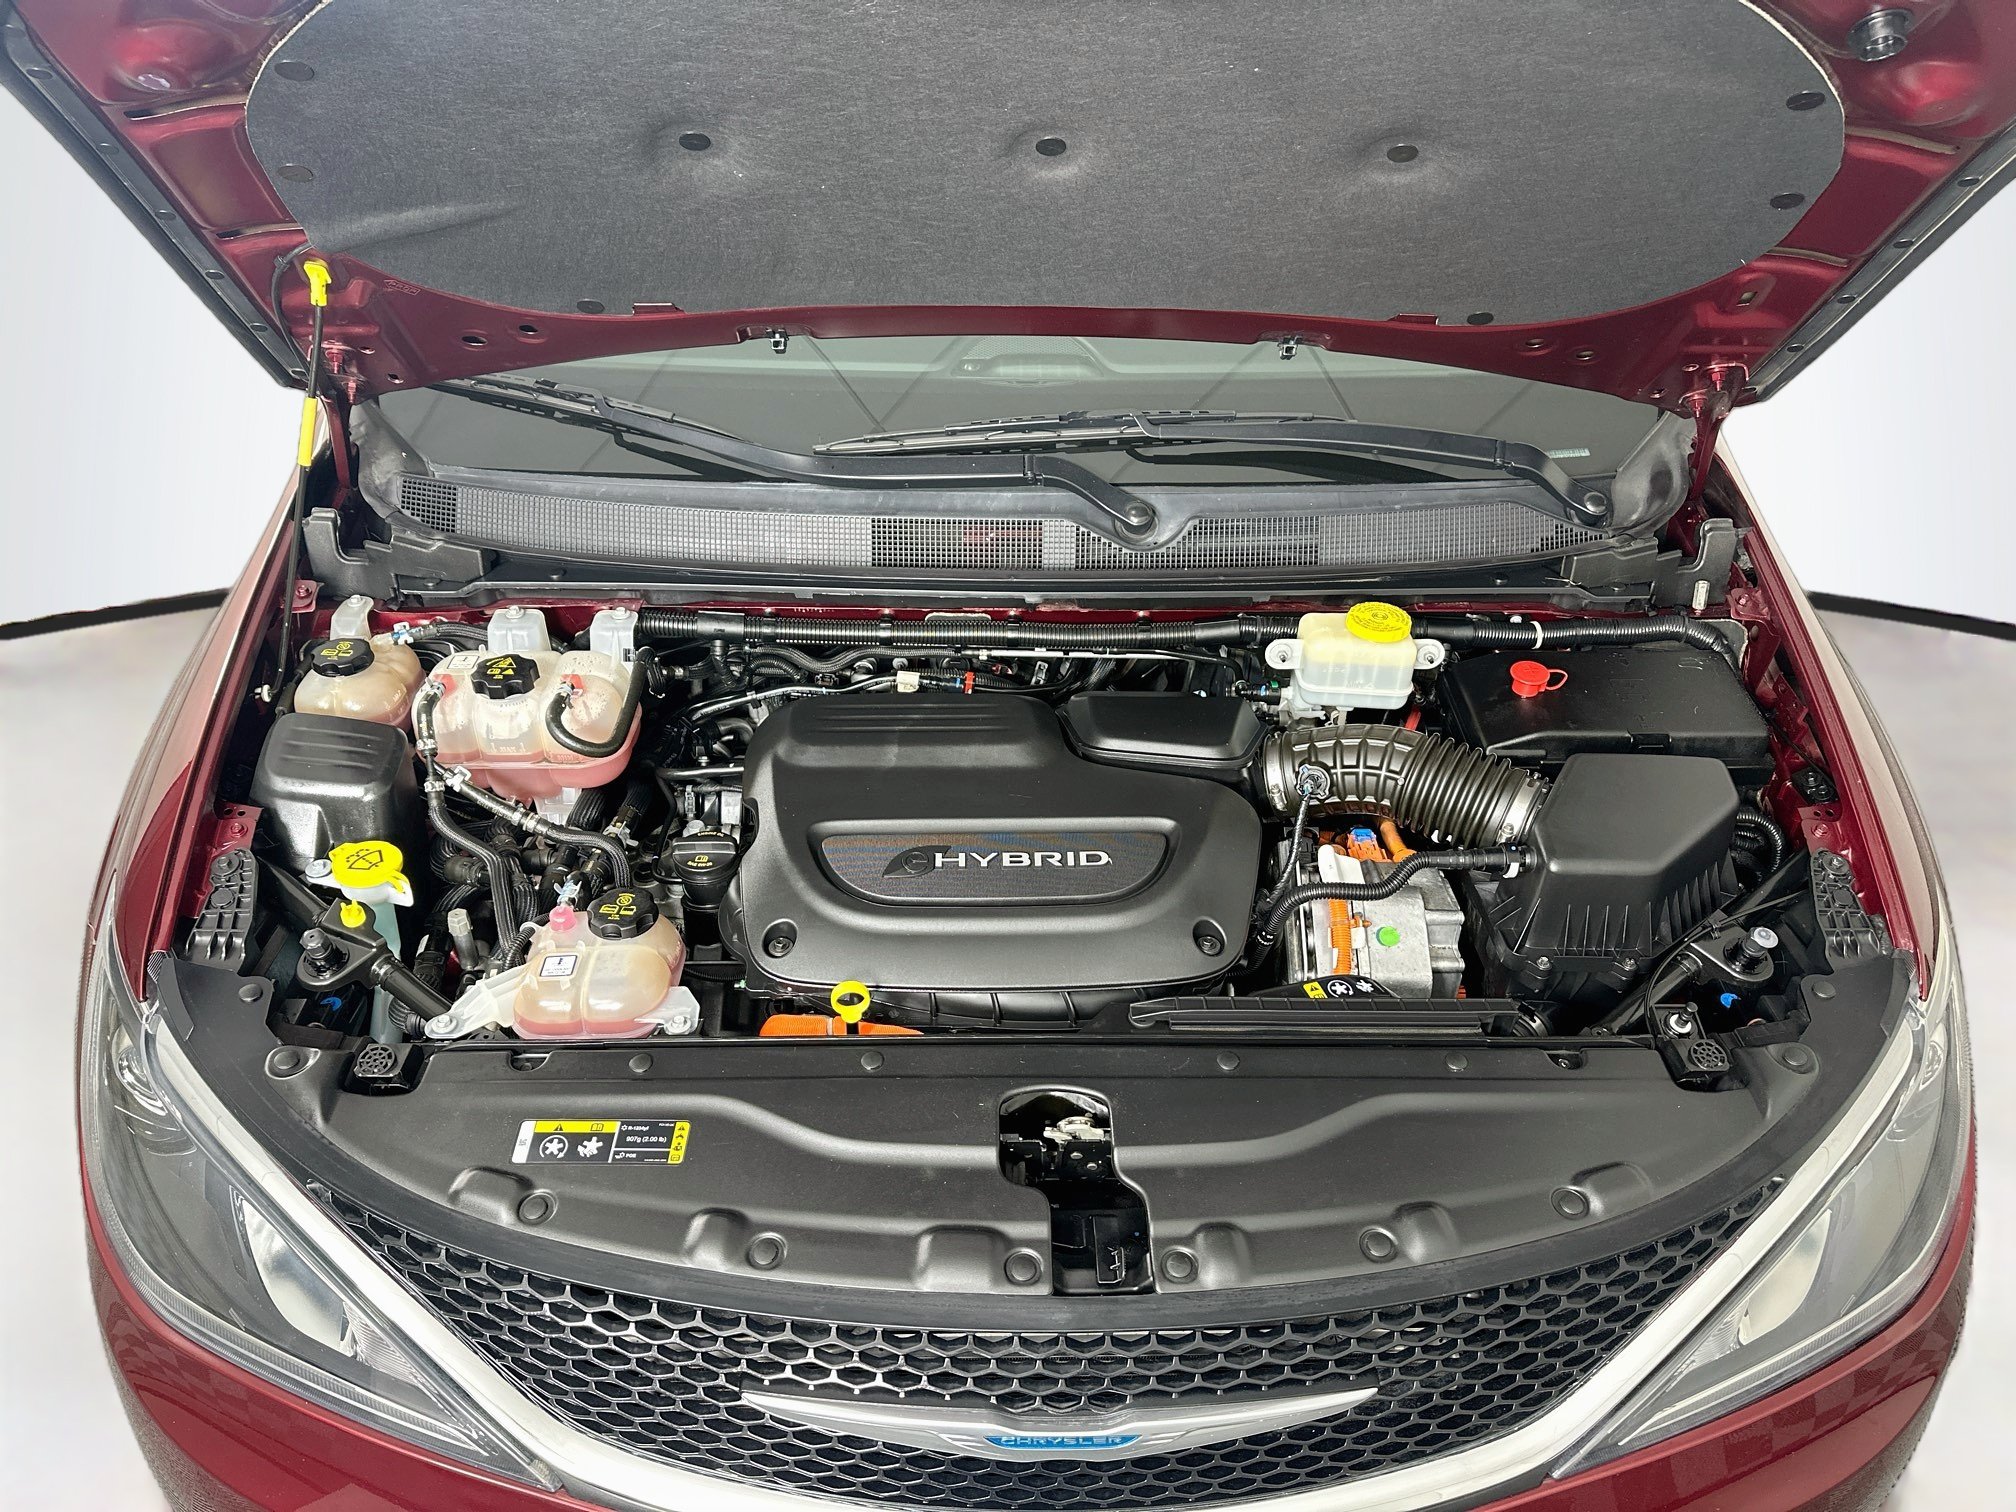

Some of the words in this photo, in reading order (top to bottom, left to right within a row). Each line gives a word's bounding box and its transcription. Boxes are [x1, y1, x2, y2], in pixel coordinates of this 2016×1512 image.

[935, 851, 1110, 867] HYBRID
[626, 1135, 642, 1143] 907g
[1001, 1436, 1122, 1445] CHRYSLER
